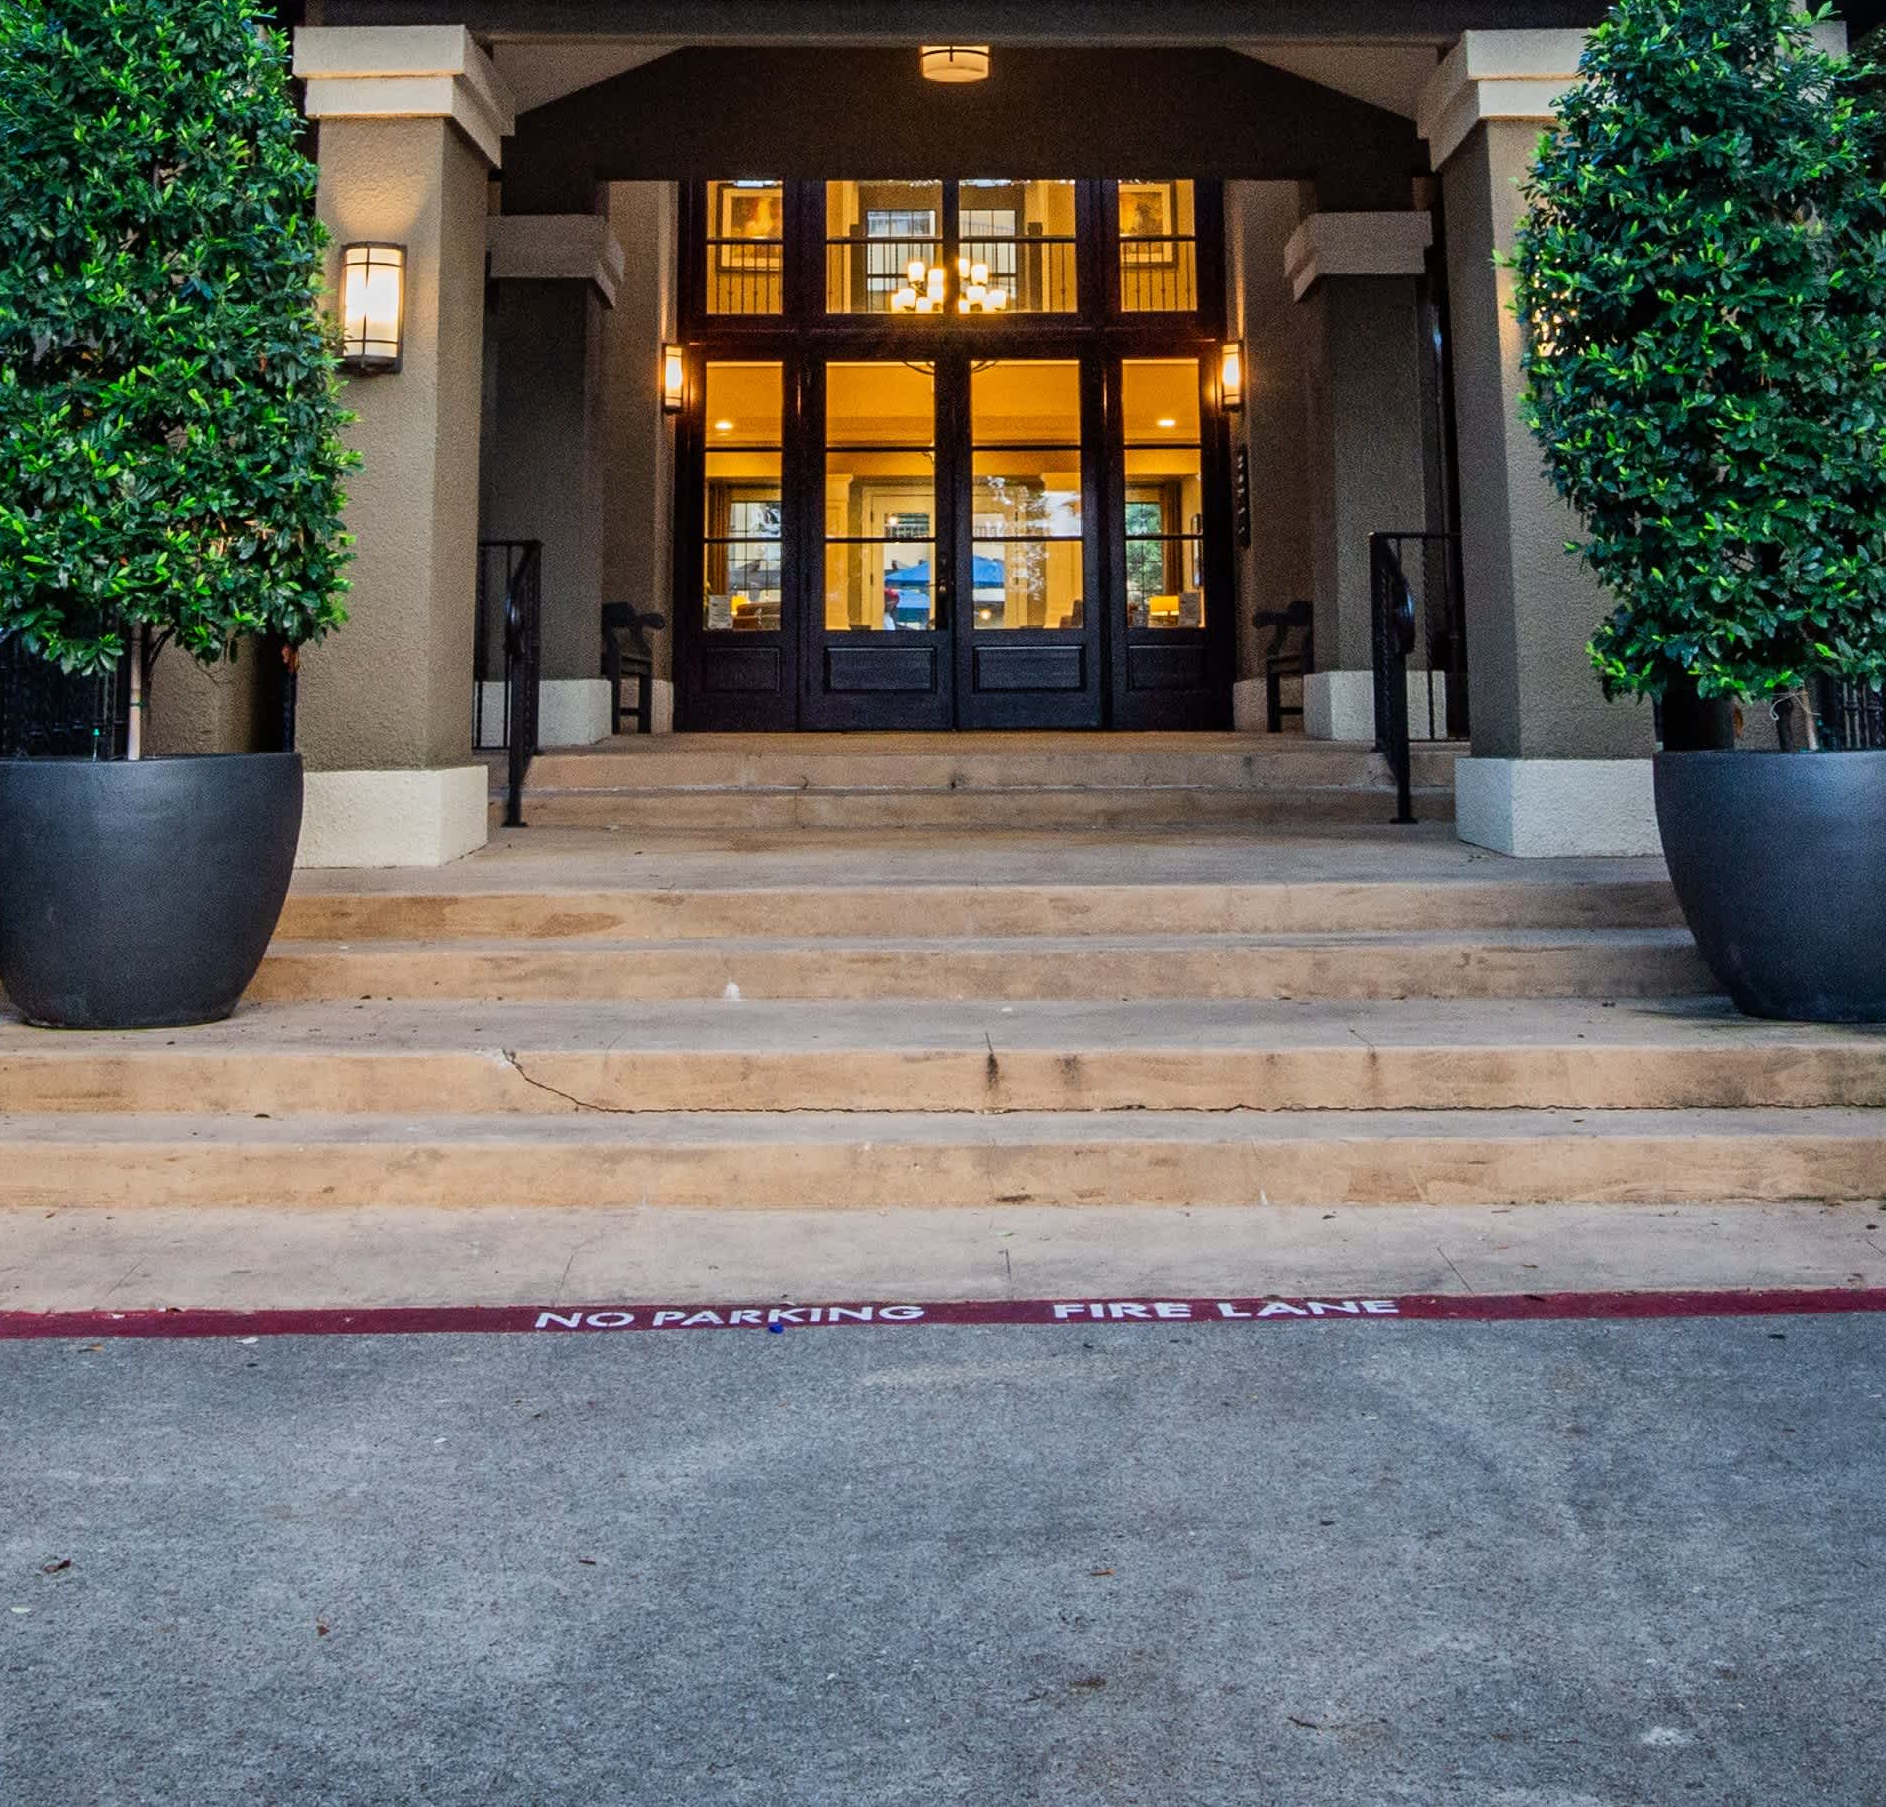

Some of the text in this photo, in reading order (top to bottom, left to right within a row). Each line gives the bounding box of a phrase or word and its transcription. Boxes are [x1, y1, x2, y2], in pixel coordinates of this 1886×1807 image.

[534, 1300, 1401, 1328] NO PARKING FIRE LANE
